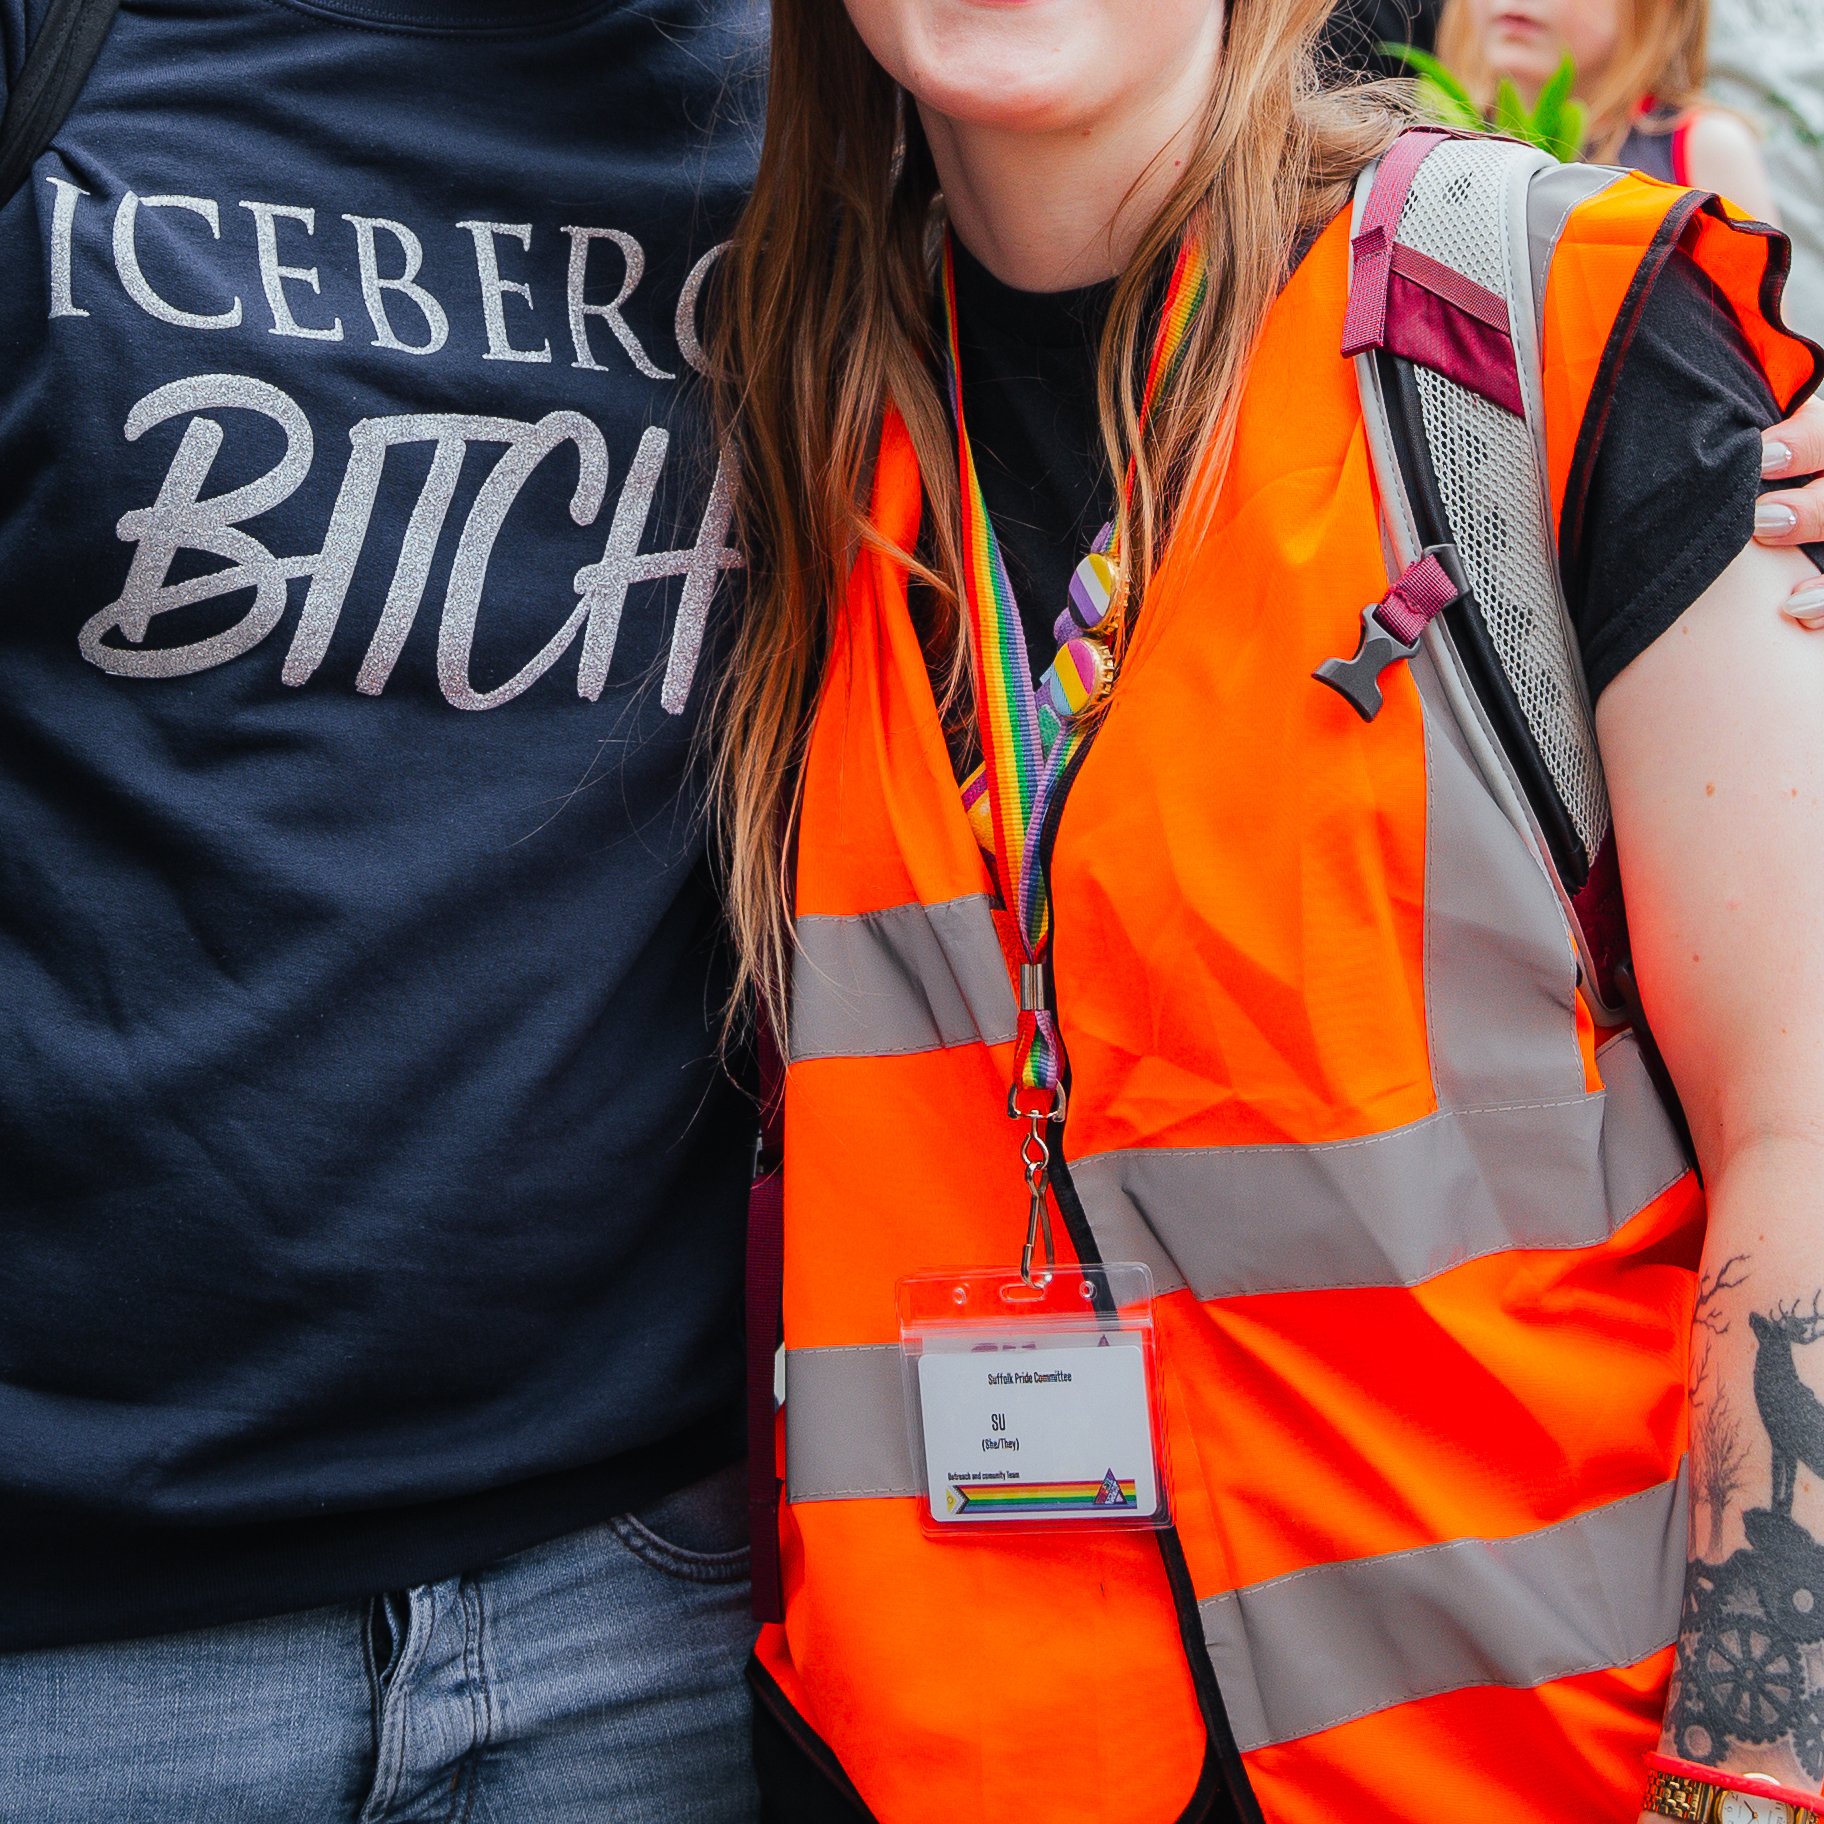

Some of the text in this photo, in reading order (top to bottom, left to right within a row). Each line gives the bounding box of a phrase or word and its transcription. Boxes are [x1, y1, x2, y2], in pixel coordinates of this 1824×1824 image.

[77, 372, 747, 717] BITCH
[987, 1370, 1072, 1385] Suffolk Pride Committee
[991, 1413, 1006, 1431] SU
[981, 1437, 1020, 1452] (She/They)
[972, 1471, 981, 1480] and
